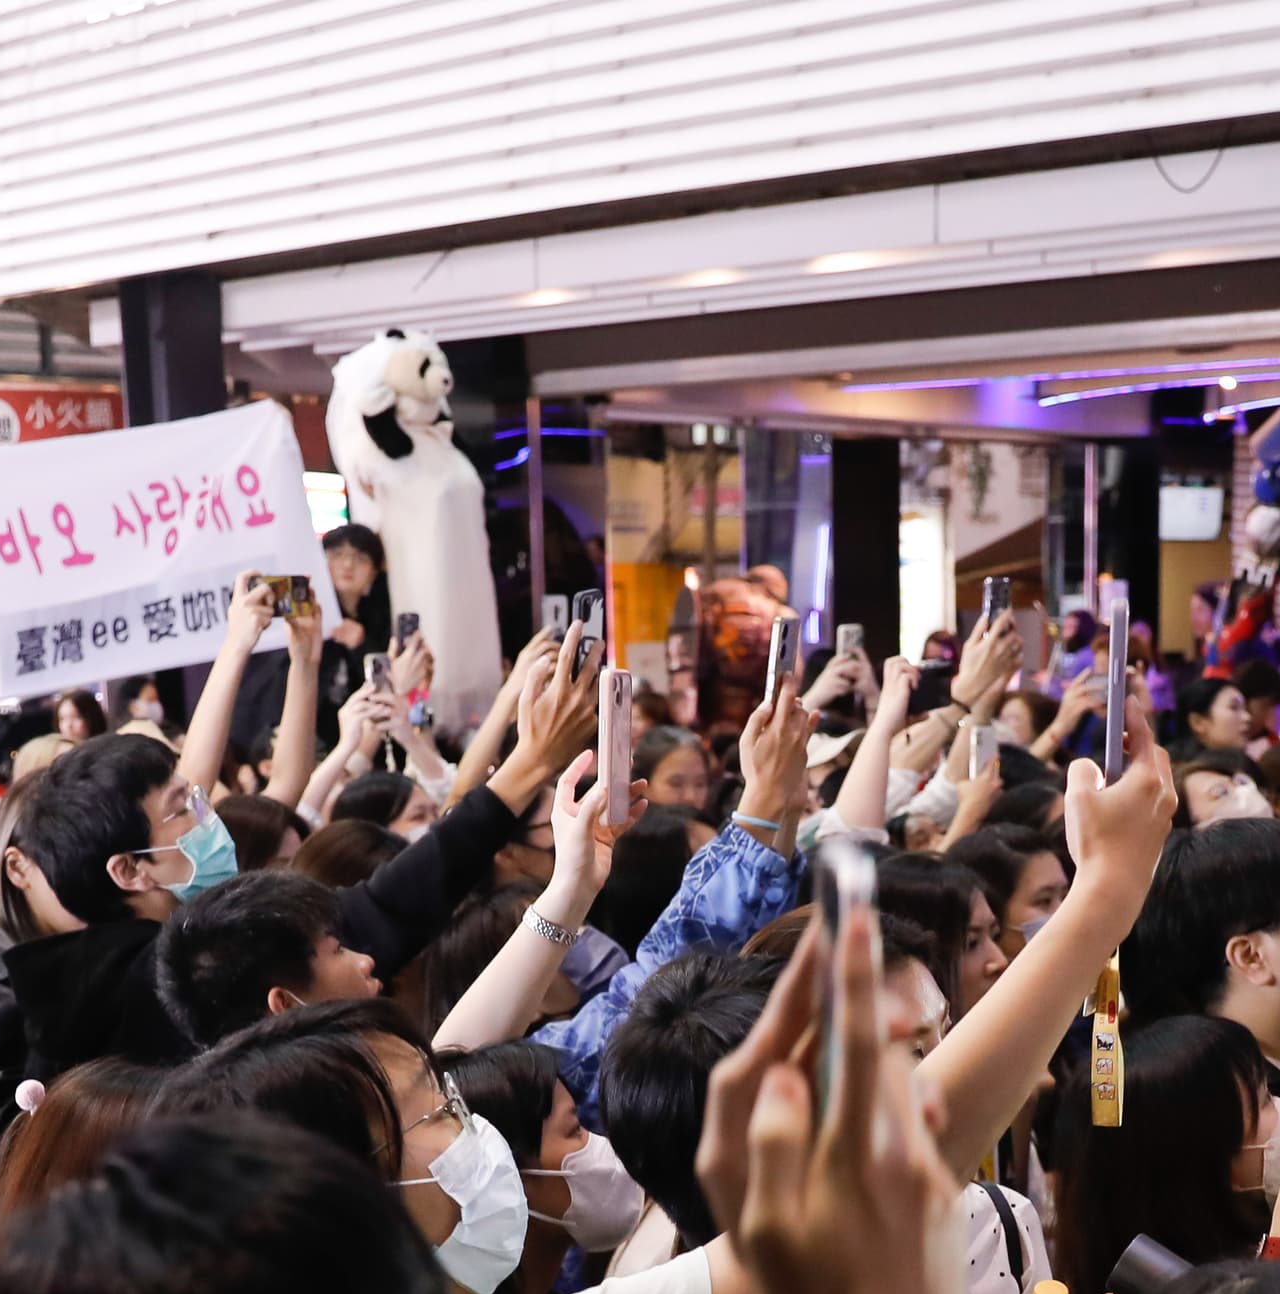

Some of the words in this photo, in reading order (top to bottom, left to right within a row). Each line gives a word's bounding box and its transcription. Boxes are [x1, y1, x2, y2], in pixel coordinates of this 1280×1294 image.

[23, 396, 113, 430] 小火鍋
[112, 464, 276, 557] 사랑해요
